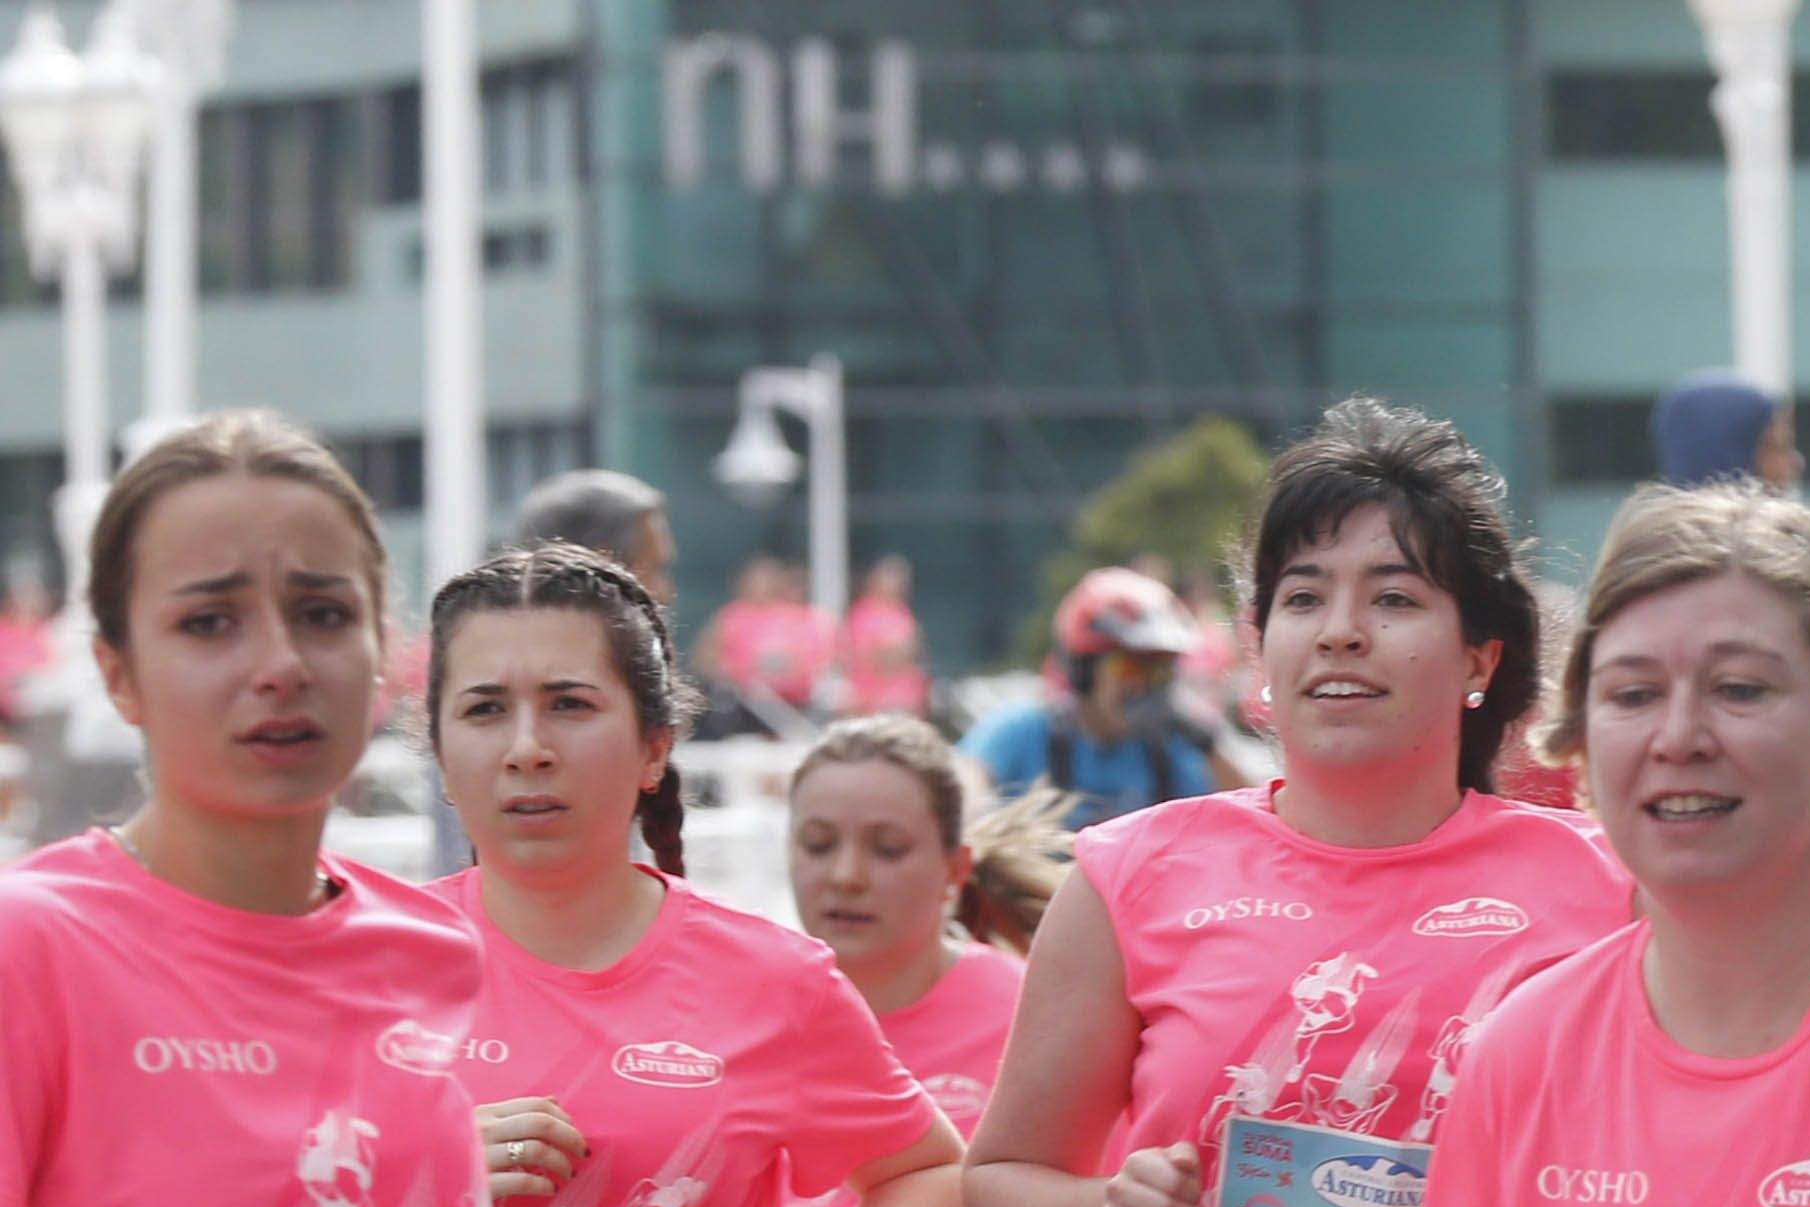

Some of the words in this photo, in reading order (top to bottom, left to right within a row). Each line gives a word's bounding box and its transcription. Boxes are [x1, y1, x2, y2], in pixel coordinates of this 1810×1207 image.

[1184, 897, 1313, 930] OYSHO
[133, 1035, 279, 1076] OYSHO
[1317, 1168, 1422, 1207] ASTURIAN
[1537, 1164, 1649, 1205] OYSHO
